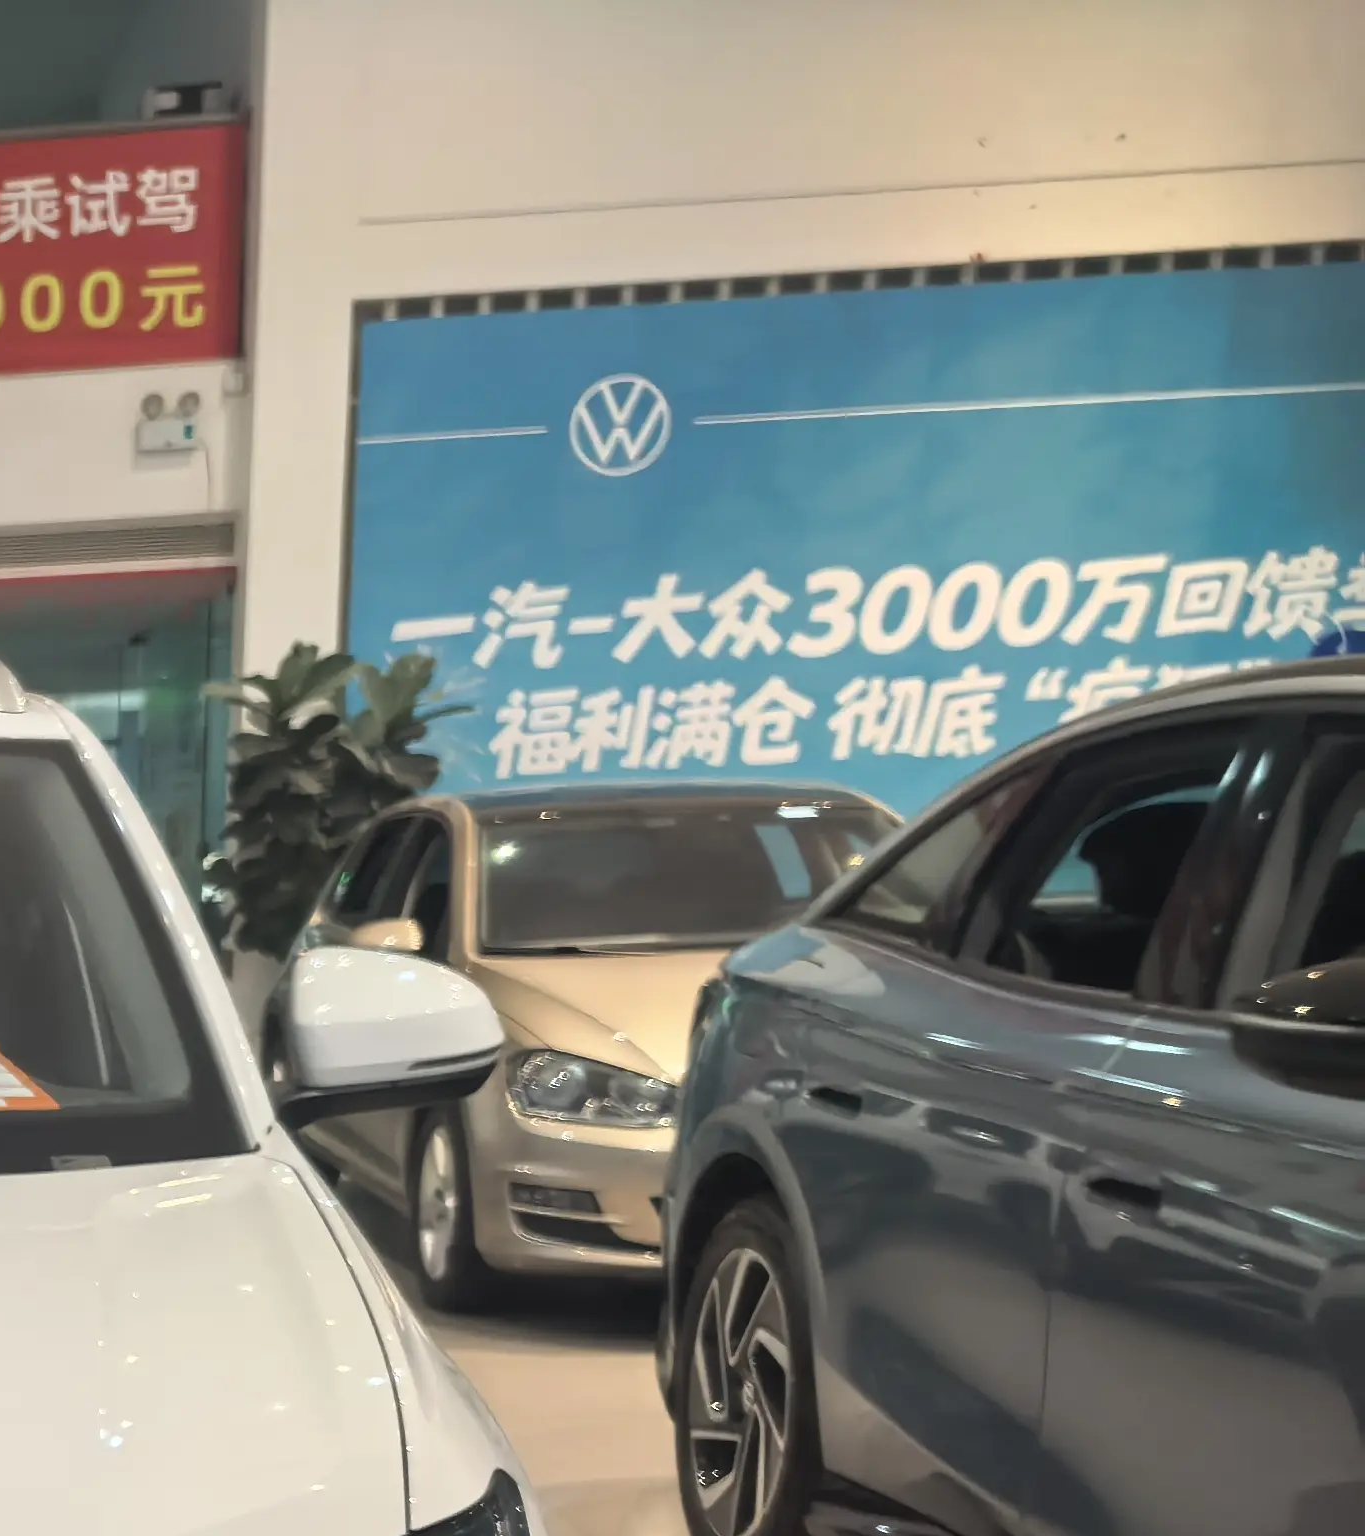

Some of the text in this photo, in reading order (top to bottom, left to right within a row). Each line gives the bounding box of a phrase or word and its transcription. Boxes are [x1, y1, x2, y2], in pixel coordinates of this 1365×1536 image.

[489, 676, 815, 780] 福利满仓
[827, 665, 1006, 760] 彻底
